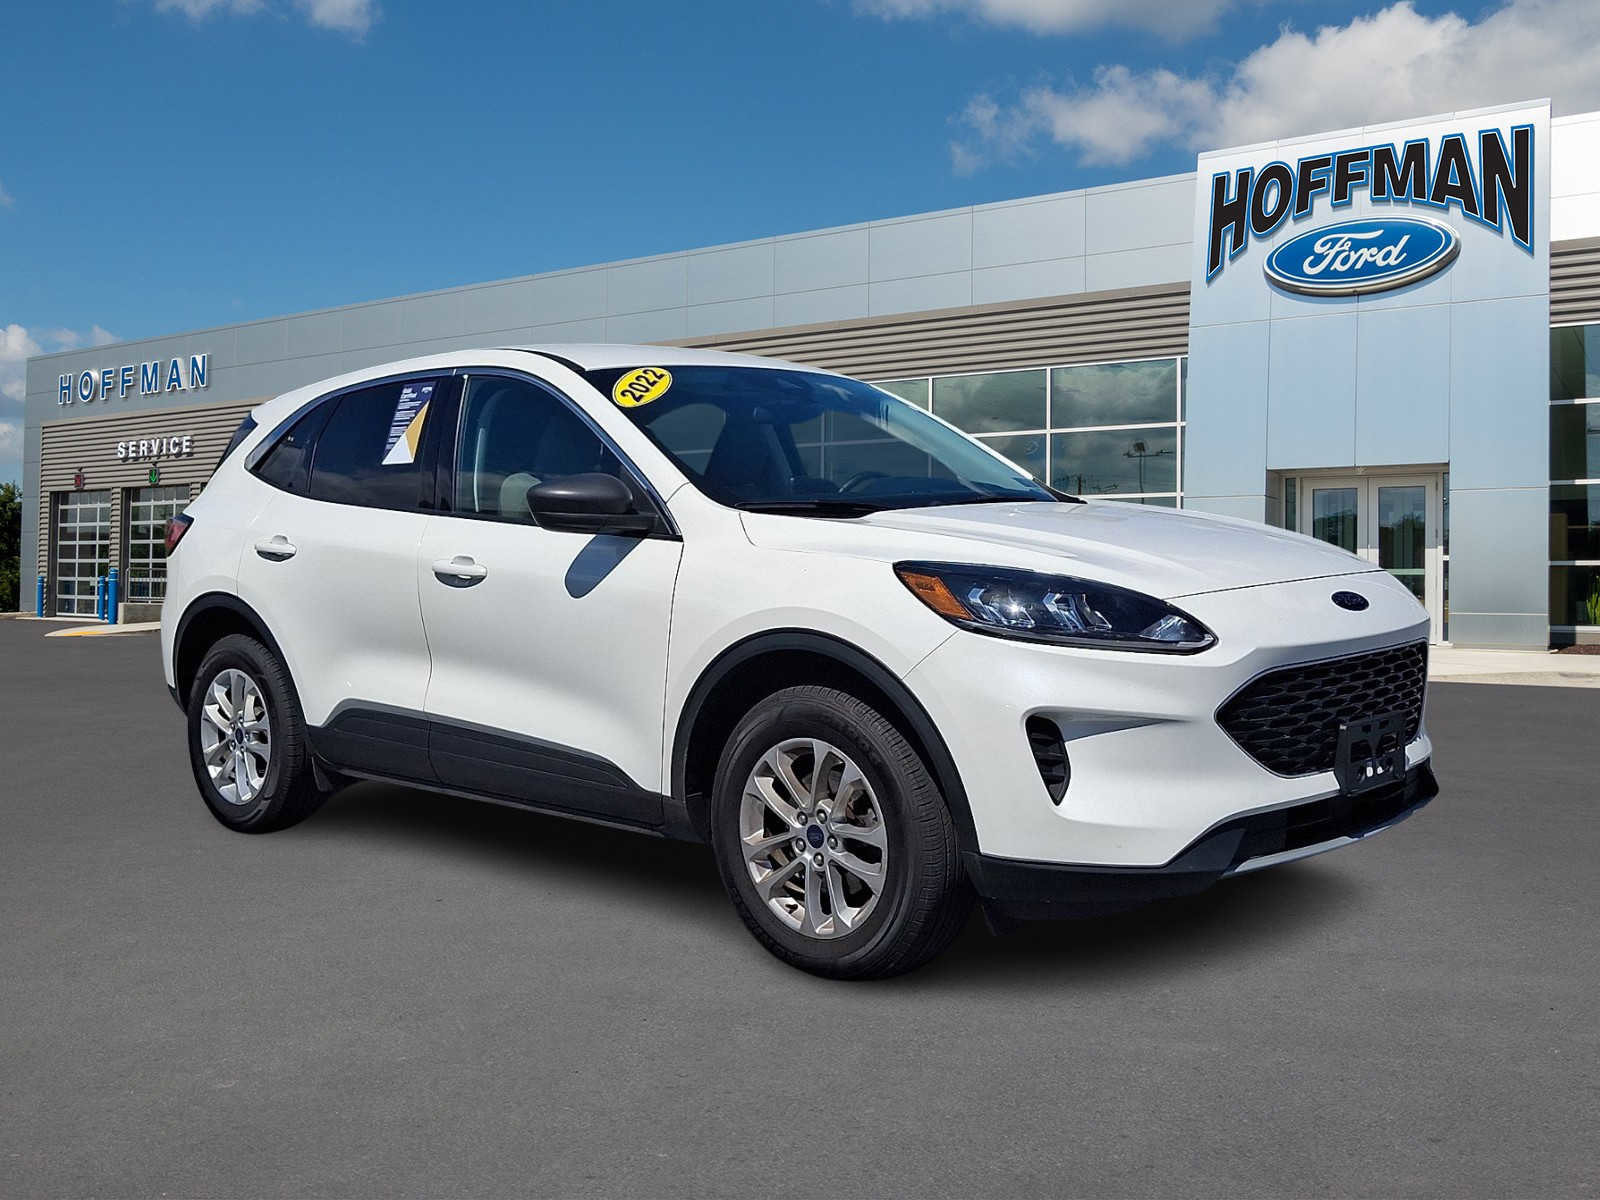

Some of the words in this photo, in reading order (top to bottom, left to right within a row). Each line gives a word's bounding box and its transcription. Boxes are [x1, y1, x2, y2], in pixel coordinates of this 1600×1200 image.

[1206, 123, 1535, 284] HOFFMAN
[1303, 229, 1411, 275] Ford
[58, 354, 208, 404] HOFFMAN
[620, 369, 665, 402] 2022
[117, 435, 193, 458] SERVICE
